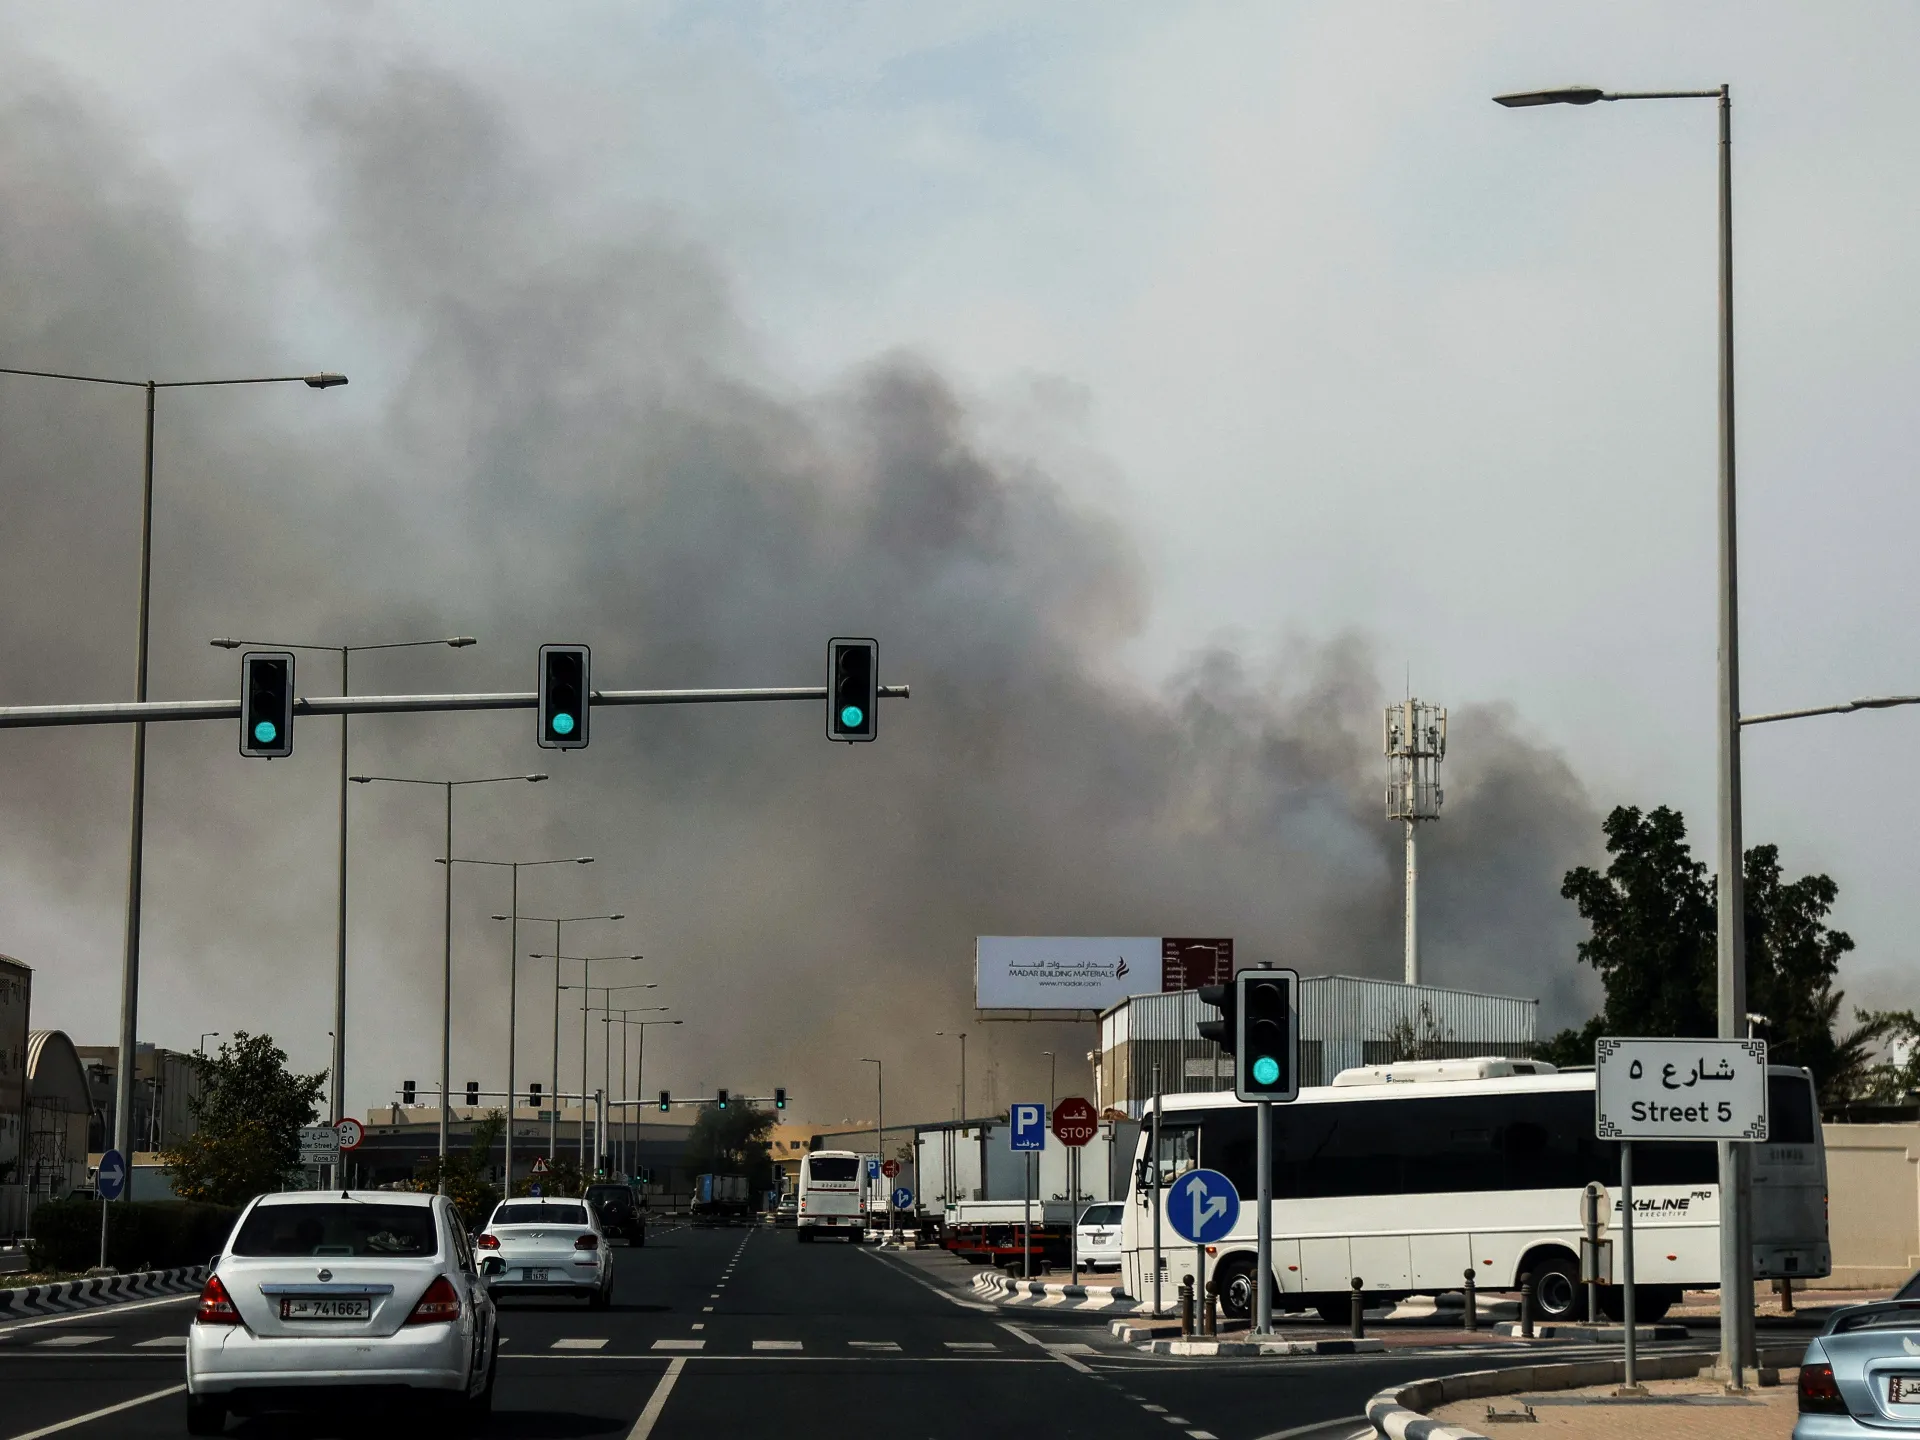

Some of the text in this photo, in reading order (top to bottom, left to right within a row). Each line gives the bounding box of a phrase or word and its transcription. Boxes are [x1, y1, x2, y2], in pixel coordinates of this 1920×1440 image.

[1008, 960, 1114, 969] مدار لمواد البناء
[1008, 969, 1115, 978] MADAR BUILDING MATERIALS
[1629, 1056, 1736, 1090] شارع ٥
[1062, 1106, 1088, 1120] قف
[1631, 1100, 1732, 1122] Street 5
[1017, 1106, 1039, 1135] P
[1060, 1127, 1093, 1139] STOP
[340, 1136, 355, 1145] 50
[1016, 1139, 1040, 1149] موقف
[1614, 1191, 1712, 1211] SKYLINE PRO
[313, 1302, 362, 1316] 741662
